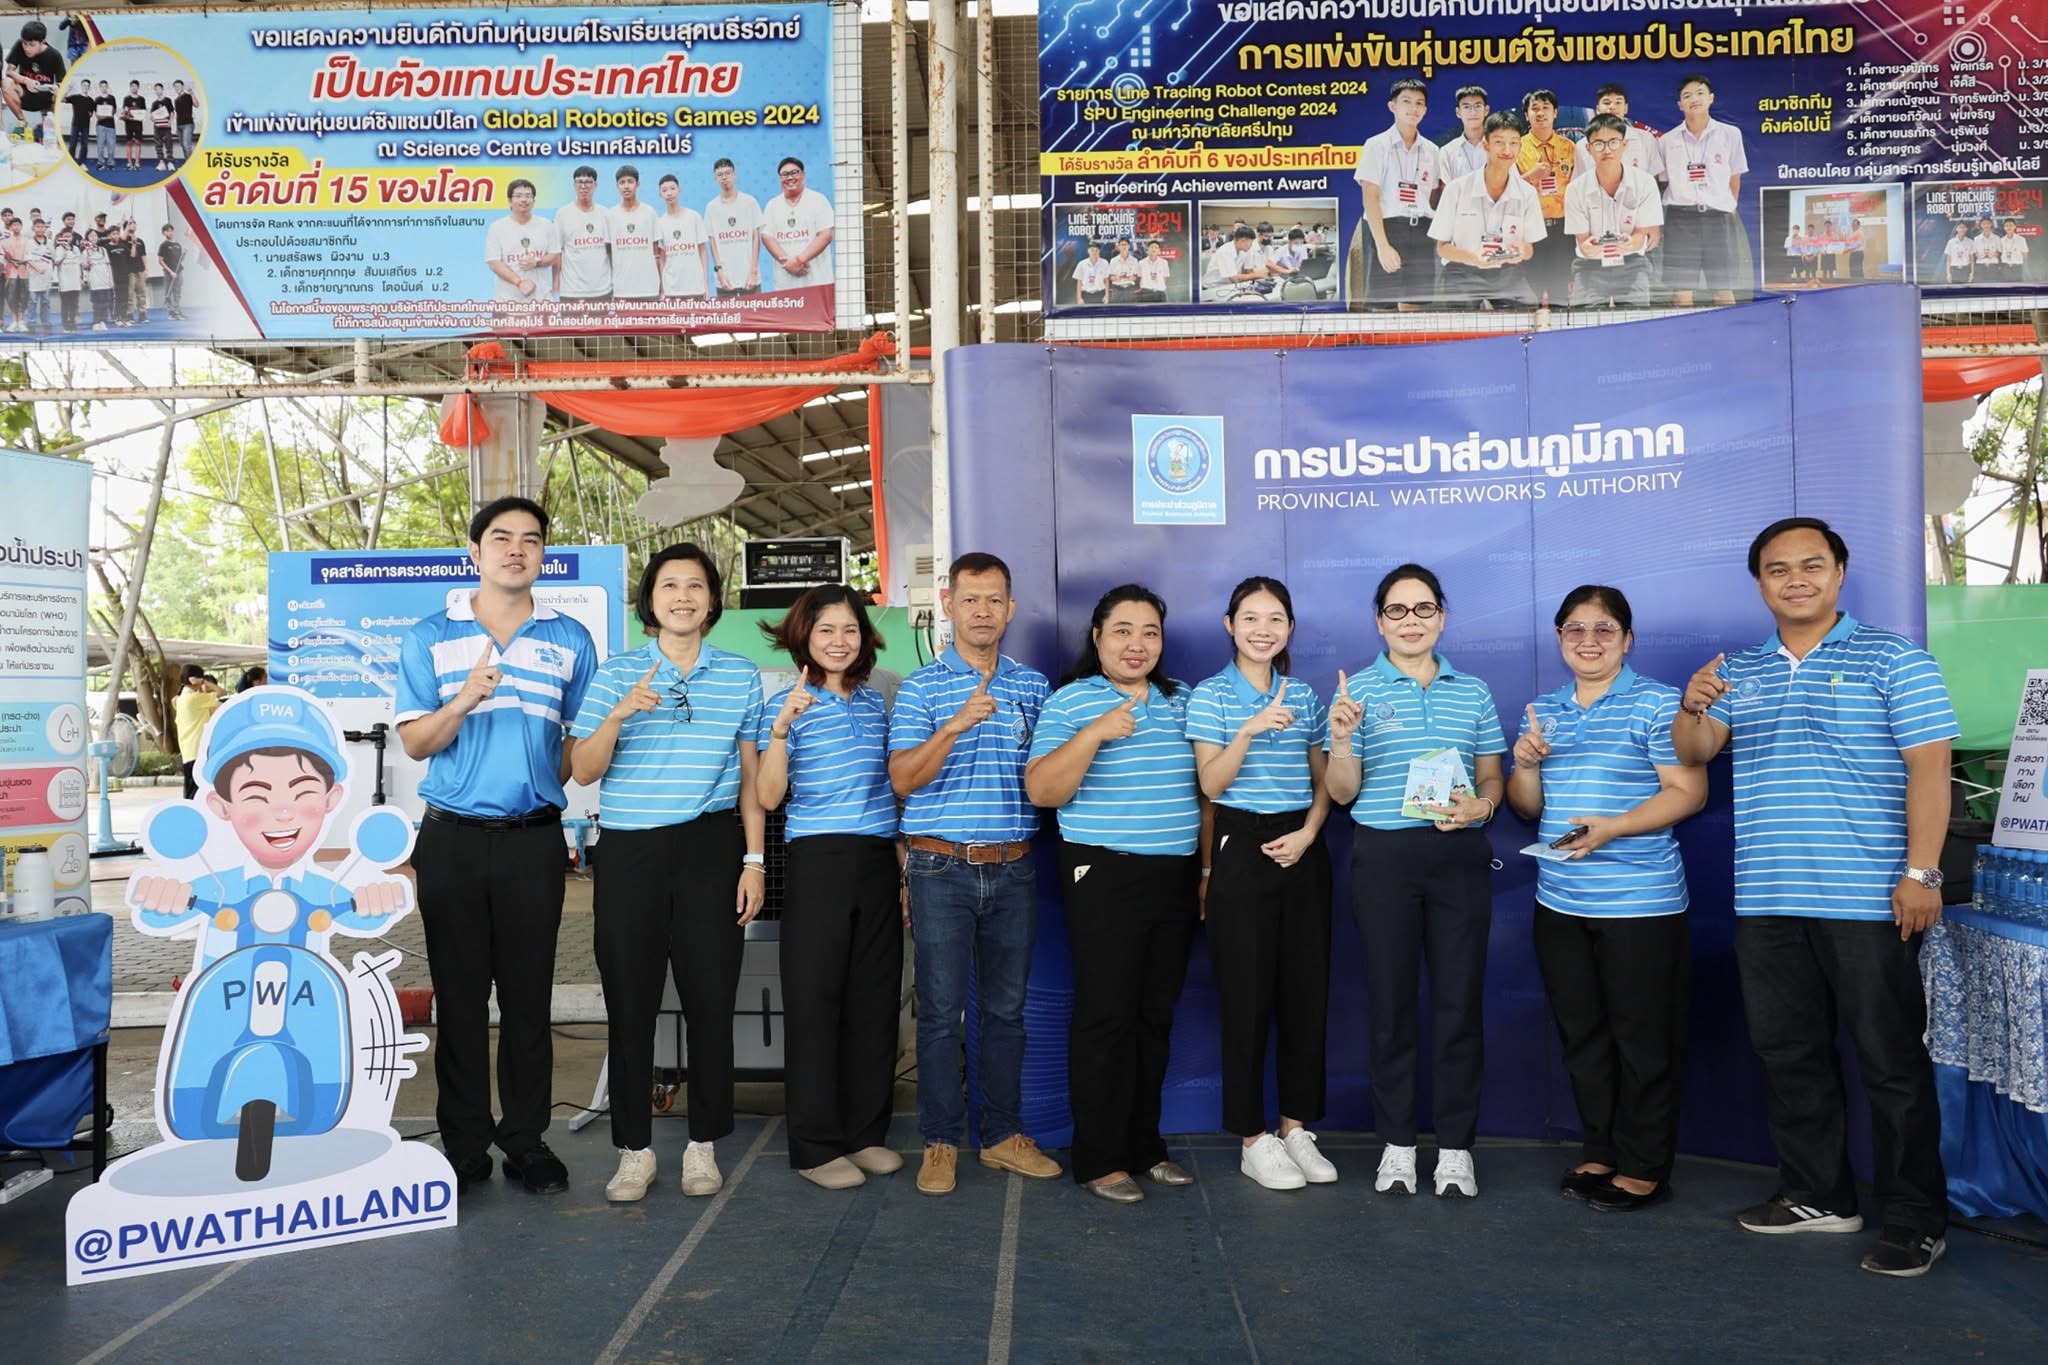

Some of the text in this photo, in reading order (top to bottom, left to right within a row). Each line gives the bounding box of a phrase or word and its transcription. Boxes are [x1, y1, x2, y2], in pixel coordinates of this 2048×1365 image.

[251, 14, 801, 51] ขอแสดงความยินดีกับทีมหุ่นยนต์โรงเรียนสุคนธีรวิทย์
[1238, 18, 1854, 77] การแข่งขันหุ่นยนต์ชิงแชมป์ประเทศไทย
[313, 54, 739, 98] เป็นตัวแทนประเทศไทย
[1846, 66, 1856, 76] 1.
[1117, 85, 1150, 100] Line
[1154, 84, 1211, 101] Tracing
[1216, 83, 1262, 97] Robot
[1266, 82, 1327, 96] Contest
[1331, 81, 1368, 95] 2024
[1846, 82, 1857, 92] 2.
[1758, 93, 1832, 111] สมาชิกทีม
[1847, 98, 1857, 108] 3.
[226, 104, 820, 137] เข้าแข่งขันหุ่นยนต์ชิงแชมป์โลก Global Robotics Games 2024
[1084, 102, 1337, 123] SPU Engineering Challenge 2024
[1761, 111, 1832, 133] ดังต่อไปนี้
[1847, 115, 1857, 124] 4.
[1132, 120, 1293, 142] ณ มหาวิทยาลัยศรีปทุม
[1847, 130, 1857, 140] 5.
[378, 133, 692, 158] ณ Science Centre ประเทศสิงคโปร์
[1847, 146, 1857, 156] 6.
[206, 150, 289, 169] ได้รับรางวัล
[1059, 142, 1357, 172] ได้รับรางวัล ลำดับที่ 6 ของประเทศไทย
[1778, 155, 2041, 181] ฝึกสอนโดย กลุ่มสาระการเรียนรู้เทคโนโลยี
[204, 159, 494, 207] ลำดับที่ 15 ของโลก
[1075, 176, 1328, 198] Engineering Achievement Award
[1926, 189, 2043, 211] LINE TRACKING 2024
[1926, 202, 1995, 214] ROBOT CONTEST
[215, 215, 265, 229] โดยการจัด
[268, 218, 294, 229] Rank
[1068, 211, 1183, 234] LINE TRACKING 2024
[1068, 224, 1135, 236] ROBOT CONTEST
[235, 234, 357, 248] ประกอบไปด้วยสมาชิกทีม
[254, 253, 262, 263] 1.
[372, 252, 390, 262] ม.3
[267, 269, 277, 278] 2.
[425, 266, 443, 276] ม.2
[281, 283, 291, 293] 3.
[432, 283, 449, 292] ม.2
[1254, 422, 1685, 478] การประปาส่วนภูมิภาค
[1257, 471, 1685, 511] PROVINCIAL WATERWORKS AUTHORITY
[40, 611, 67, 621] (WHO)
[258, 703, 295, 718] PWA
[2013, 754, 2044, 763] สะดวก
[2012, 779, 2034, 790] เลือก
[2012, 792, 2030, 803] ใหม่
[222, 979, 317, 1010] PWA
[74, 1180, 452, 1264] @PWATHAILAND
